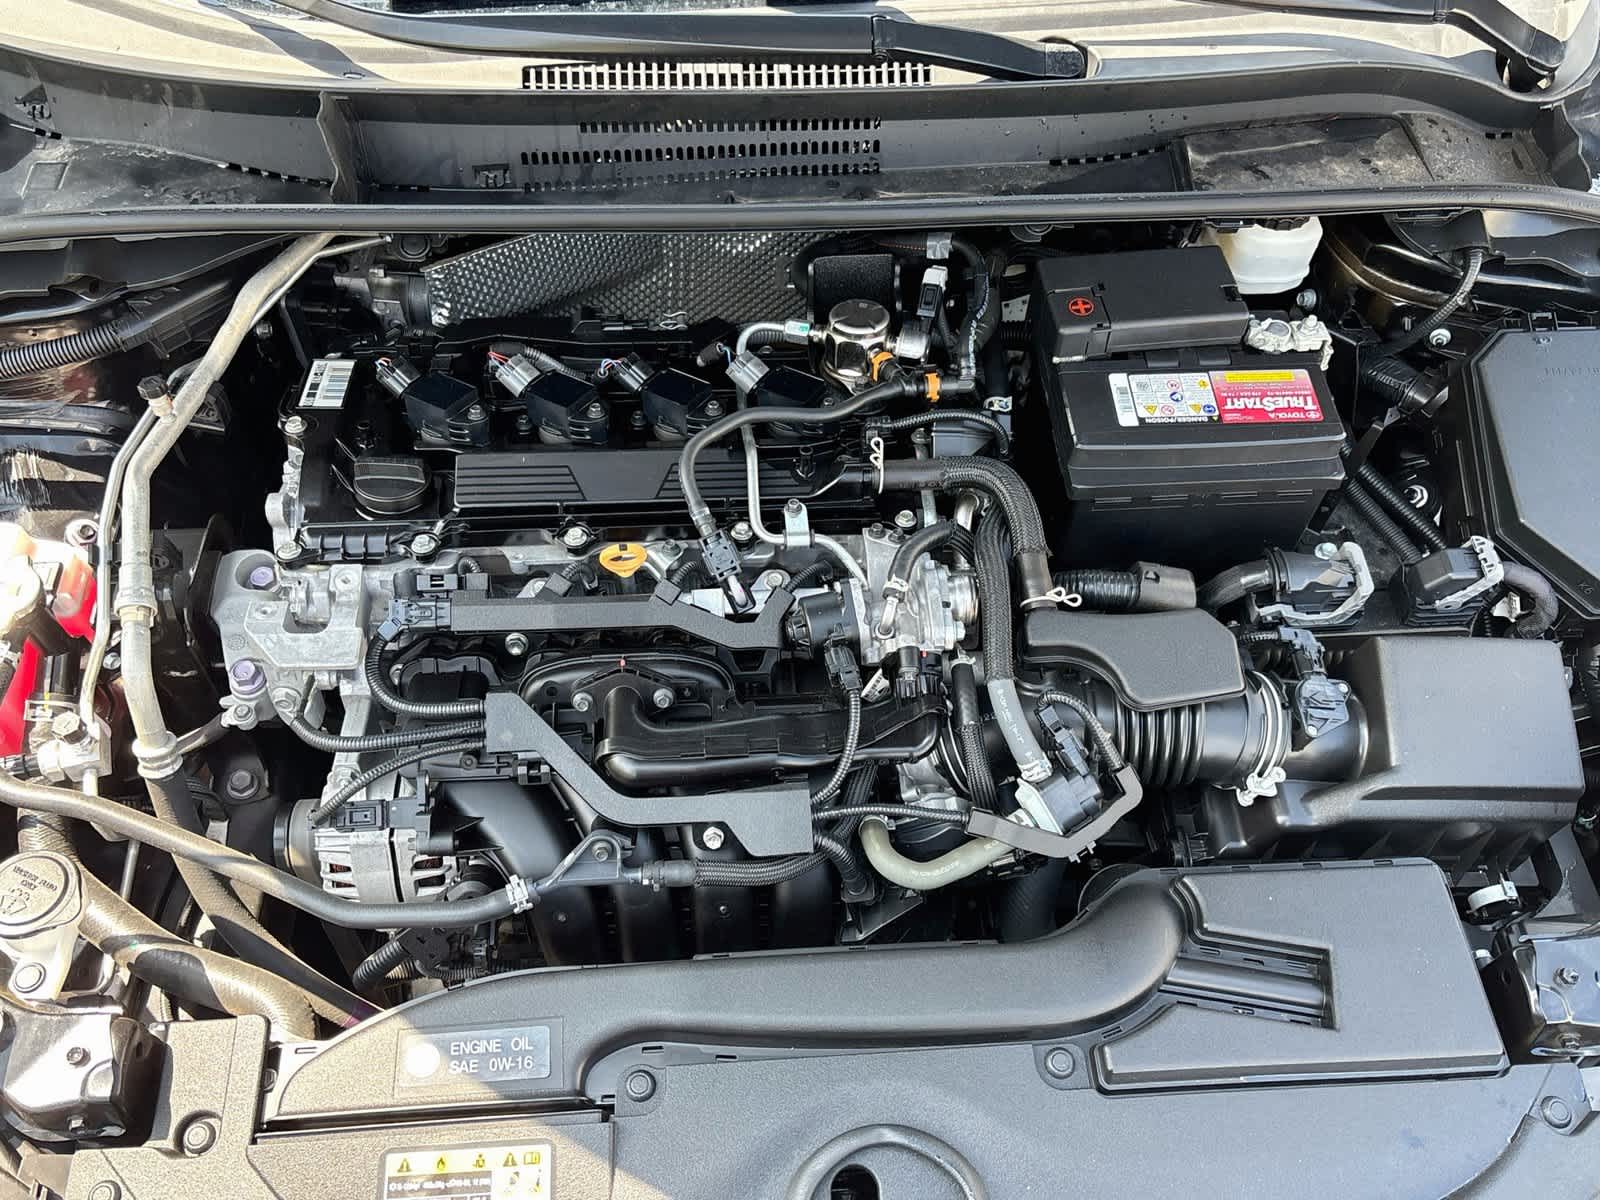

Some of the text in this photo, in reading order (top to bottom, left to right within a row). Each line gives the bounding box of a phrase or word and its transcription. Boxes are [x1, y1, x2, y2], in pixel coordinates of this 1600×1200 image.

[450, 1036, 534, 1056] ENGINE OIL
[448, 1055, 533, 1074] SAE 0W-16
